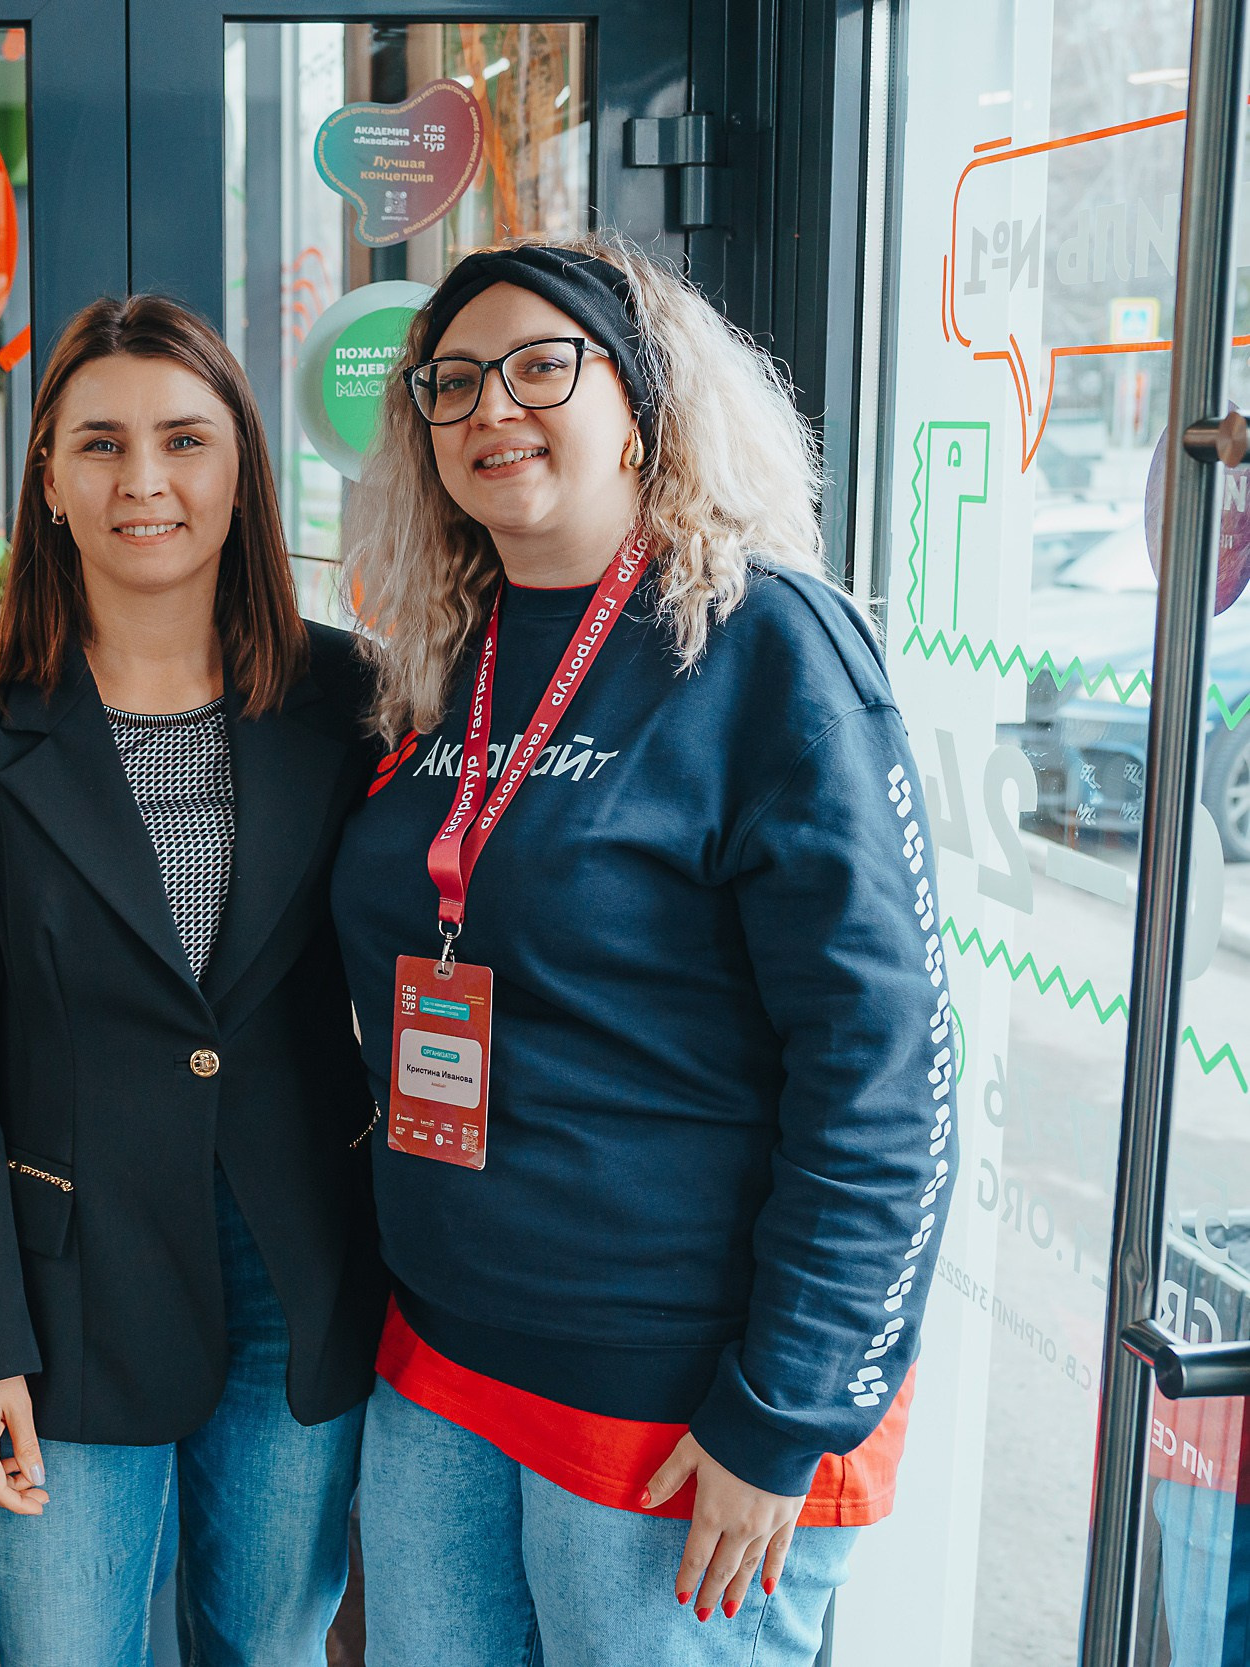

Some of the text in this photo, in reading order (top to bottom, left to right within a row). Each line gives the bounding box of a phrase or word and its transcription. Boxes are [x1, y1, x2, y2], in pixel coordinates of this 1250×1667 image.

[354, 125, 410, 137] АКАДЕМИЯ
[423, 124, 446, 133] гас
[423, 133, 446, 142] тро
[423, 142, 445, 152] тур
[373, 156, 426, 170] Лучшая
[360, 170, 434, 183] концепция
[336, 346, 406, 359] ПОЖАЛУ
[336, 380, 386, 397] МАС
[551, 597, 617, 706] гастротур
[439, 636, 494, 840] гастротур гастротур
[412, 734, 619, 781] Акаайт
[480, 722, 549, 830] гастротур
[402, 993, 416, 1001] тро
[401, 1001, 416, 1010] тур
[423, 1049, 458, 1060] ОРГАНИЗАТОР
[406, 1063, 473, 1083] Кристина Иванова
